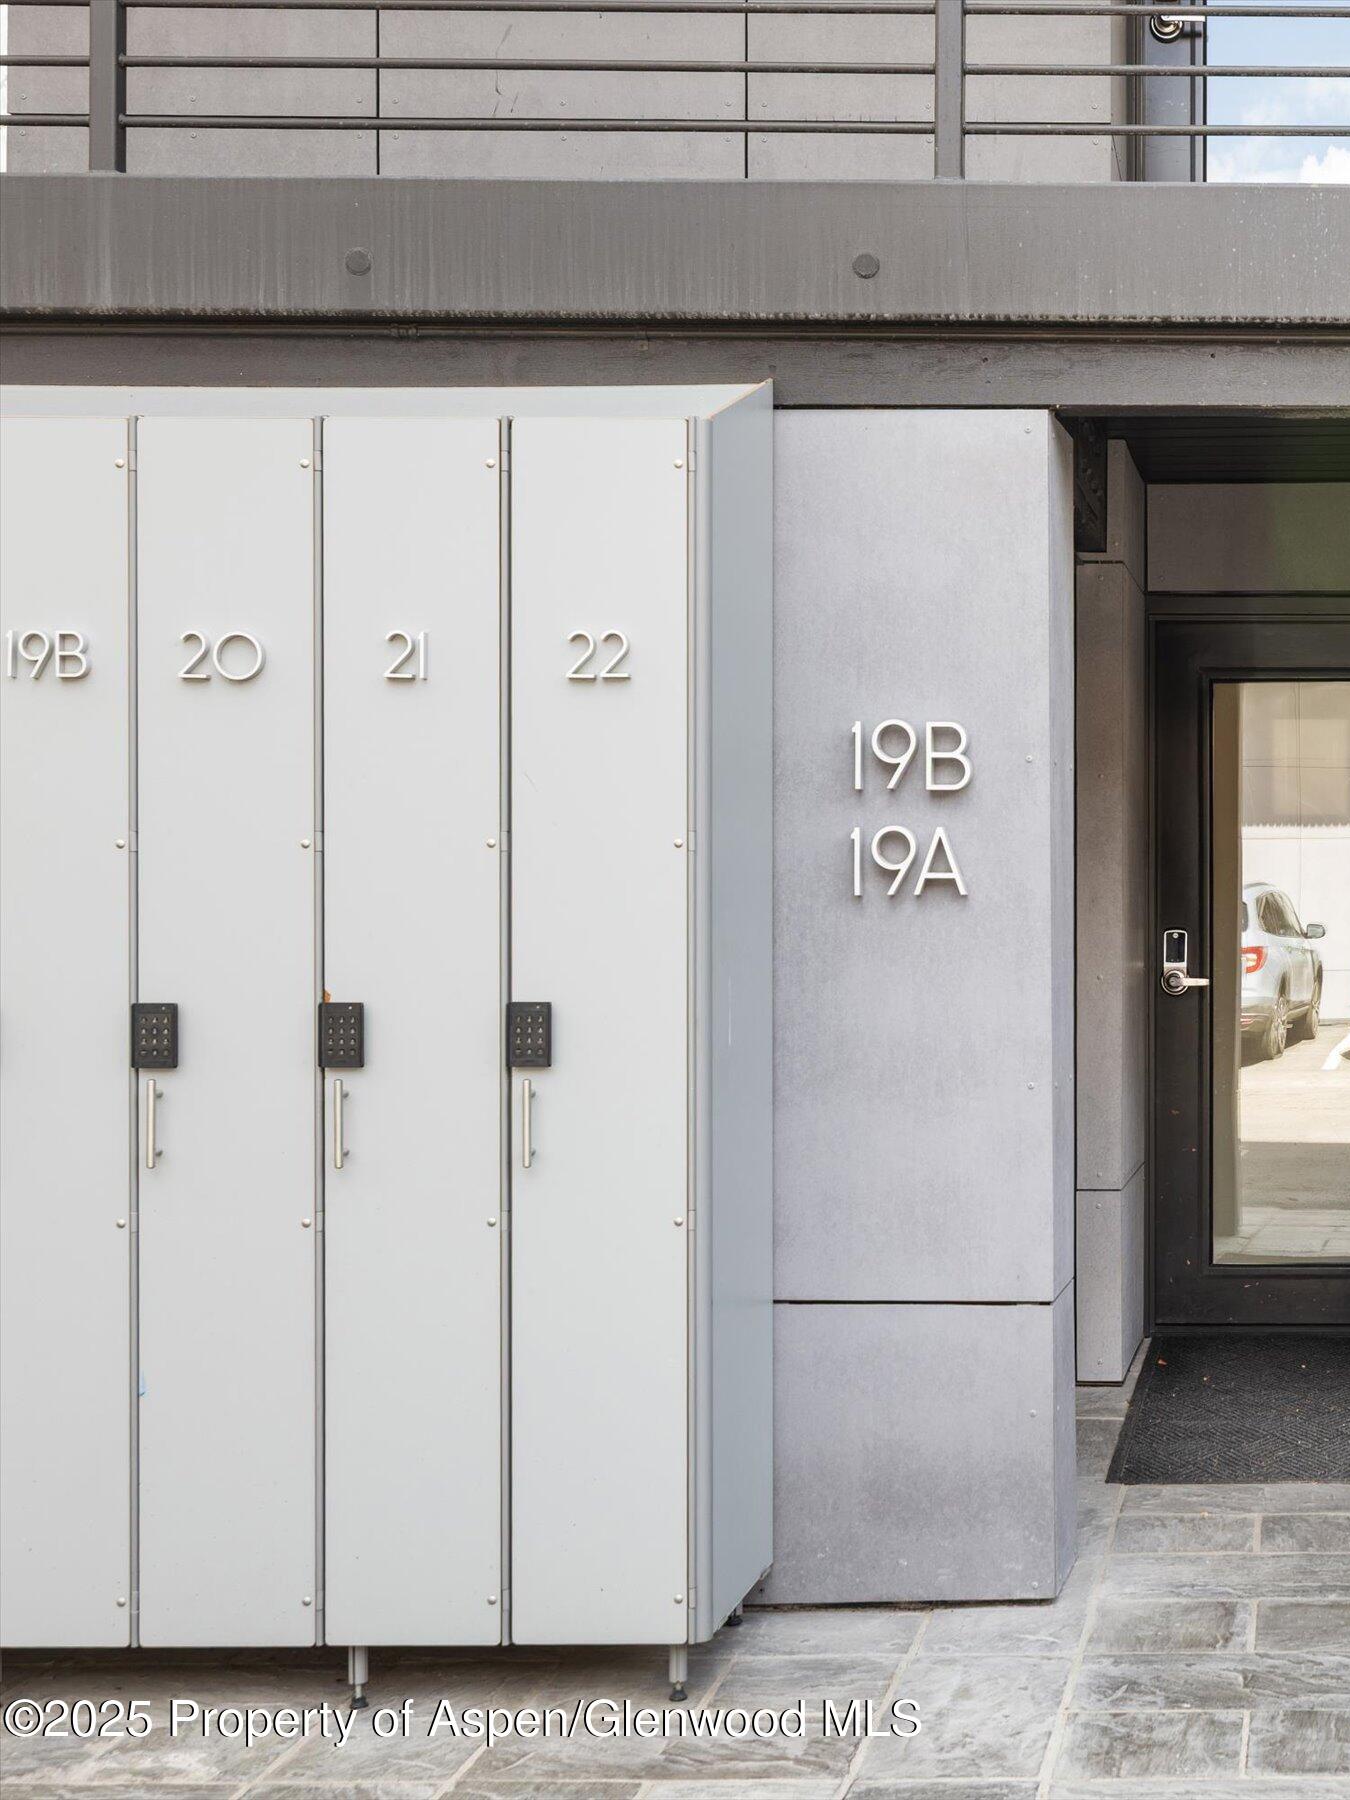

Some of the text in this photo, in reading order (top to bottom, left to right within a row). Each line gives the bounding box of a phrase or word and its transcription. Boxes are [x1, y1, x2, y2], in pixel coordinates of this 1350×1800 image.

[5, 630, 91, 679] 19B
[177, 631, 265, 681] 20
[384, 630, 428, 680] 21
[566, 630, 632, 680] 22
[851, 719, 973, 792] 19B
[850, 825, 968, 896] 19A
